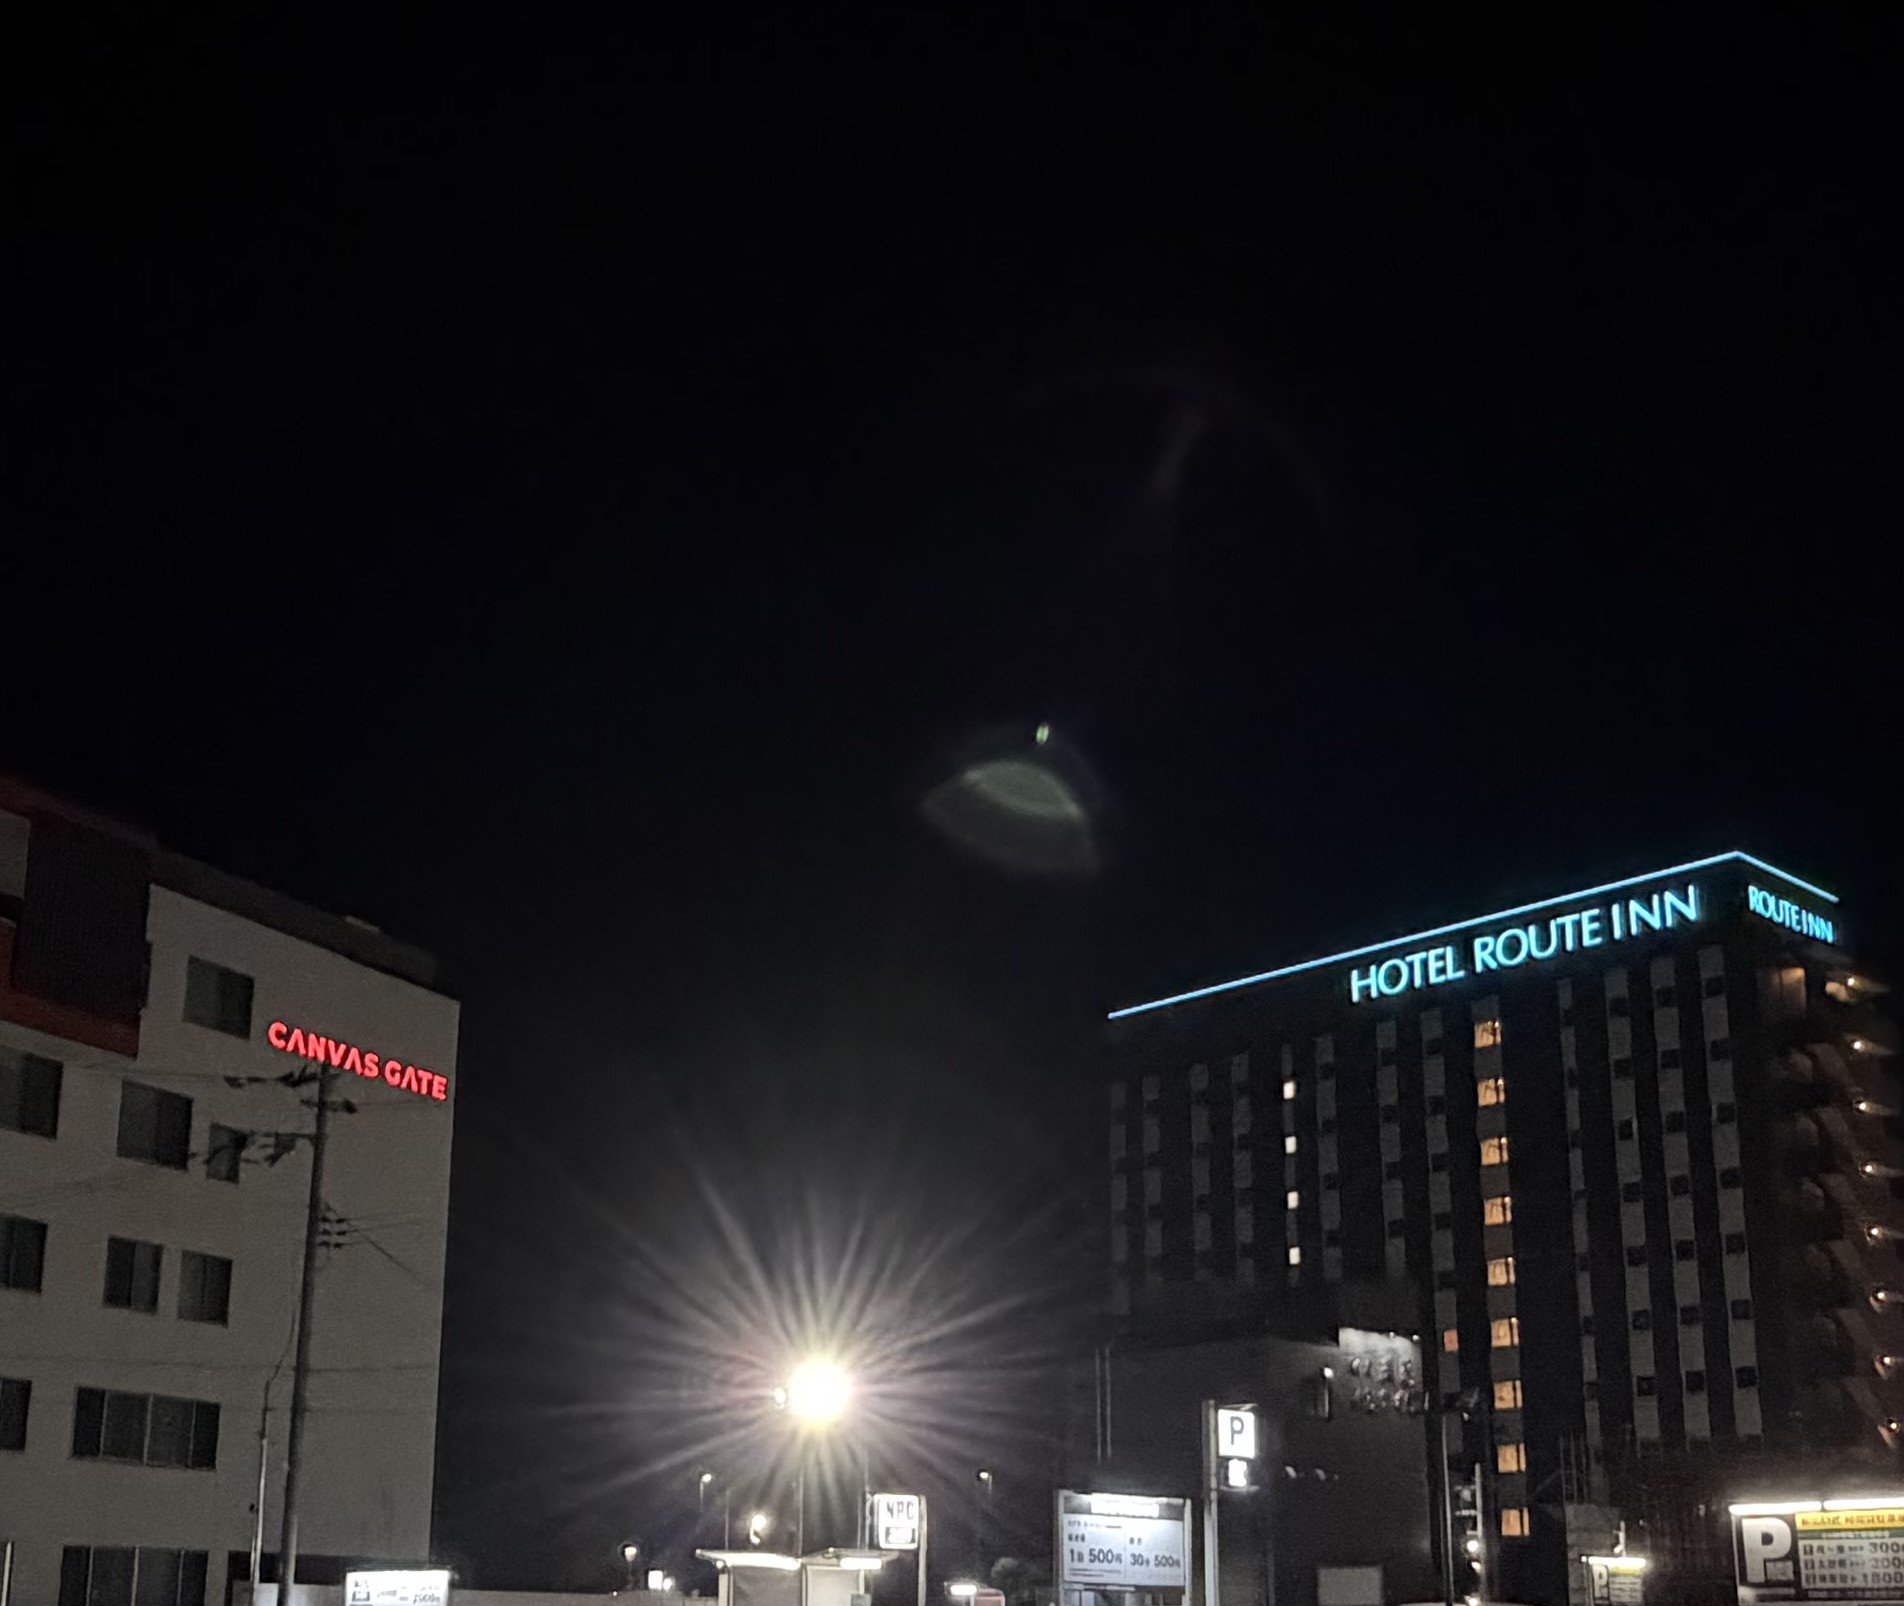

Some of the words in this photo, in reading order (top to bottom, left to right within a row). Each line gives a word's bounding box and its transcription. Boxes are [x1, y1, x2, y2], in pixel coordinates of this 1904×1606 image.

[1350, 945, 1466, 1004] HOTEL
[1473, 907, 1604, 975] ROUTE
[1610, 884, 1699, 941] INN
[1747, 884, 1802, 933] ROUTE
[1801, 908, 1834, 944] INN
[266, 1020, 381, 1079] CANVAS
[383, 1059, 448, 1102] GATE
[1229, 1415, 1245, 1446] P
[886, 1500, 915, 1521] NPC
[1741, 1517, 1792, 1583] P
